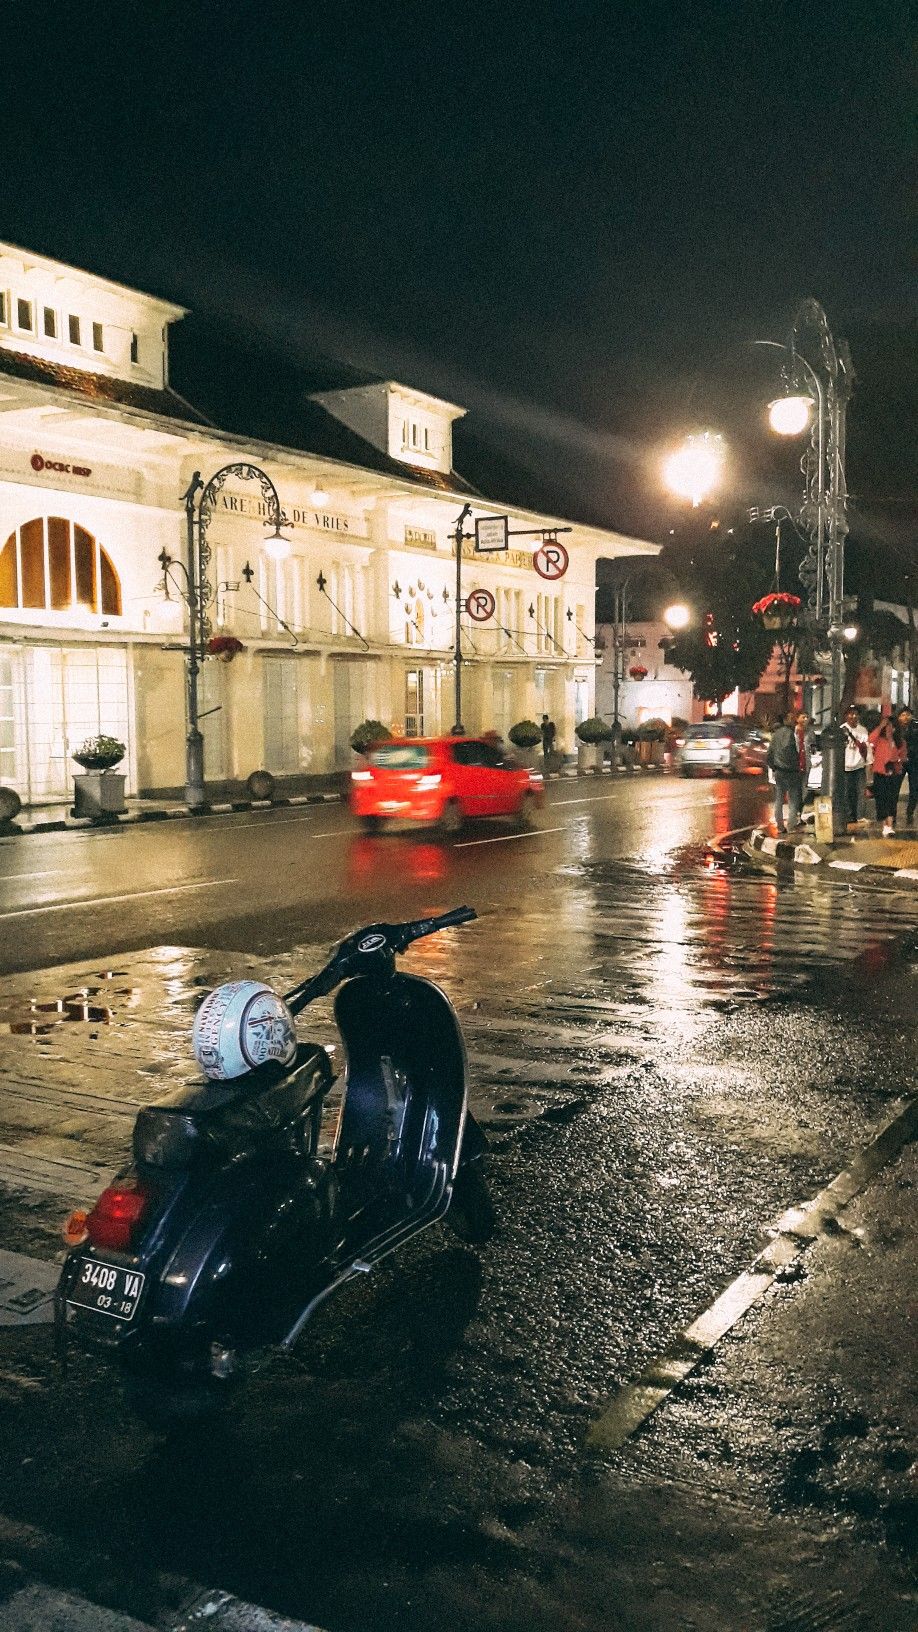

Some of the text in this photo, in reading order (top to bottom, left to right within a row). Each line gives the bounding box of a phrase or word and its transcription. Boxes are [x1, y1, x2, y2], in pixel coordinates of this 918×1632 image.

[45, 460, 71, 473] OCBC
[294, 510, 308, 524] DE
[315, 514, 349, 531] VRIES
[81, 1263, 139, 1297] 3408 VA
